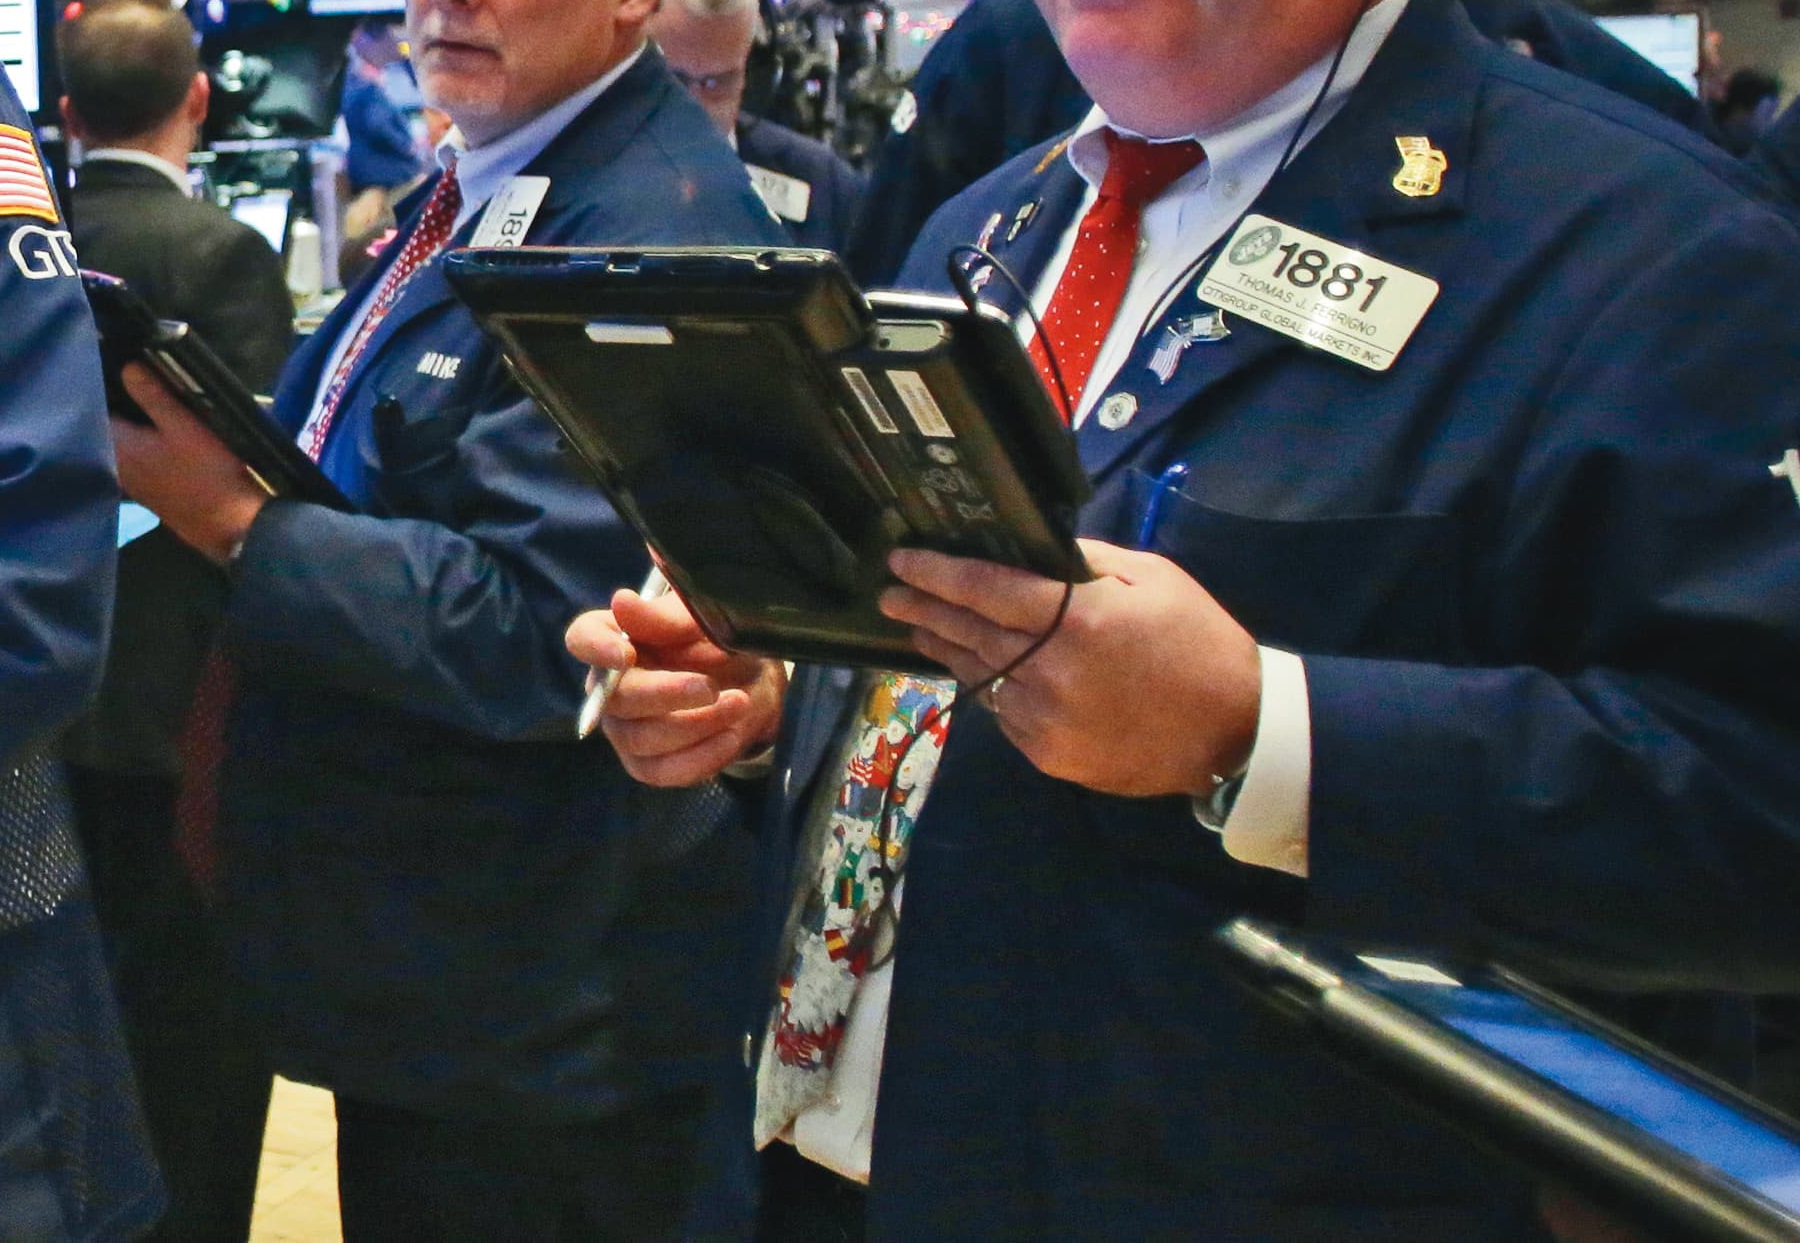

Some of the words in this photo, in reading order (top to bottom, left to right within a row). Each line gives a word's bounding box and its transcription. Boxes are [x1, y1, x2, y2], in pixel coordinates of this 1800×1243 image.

[8, 224, 80, 279] GT
[1273, 242, 1388, 313] 1881
[1202, 285, 1258, 315] CITIGROUP
[1260, 310, 1303, 335] GLOBAL
[1308, 329, 1360, 357] MARKETS
[1238, 273, 1293, 303] THOMAS
[1312, 303, 1377, 337] FERRIGNO
[417, 352, 461, 379] MIKE
